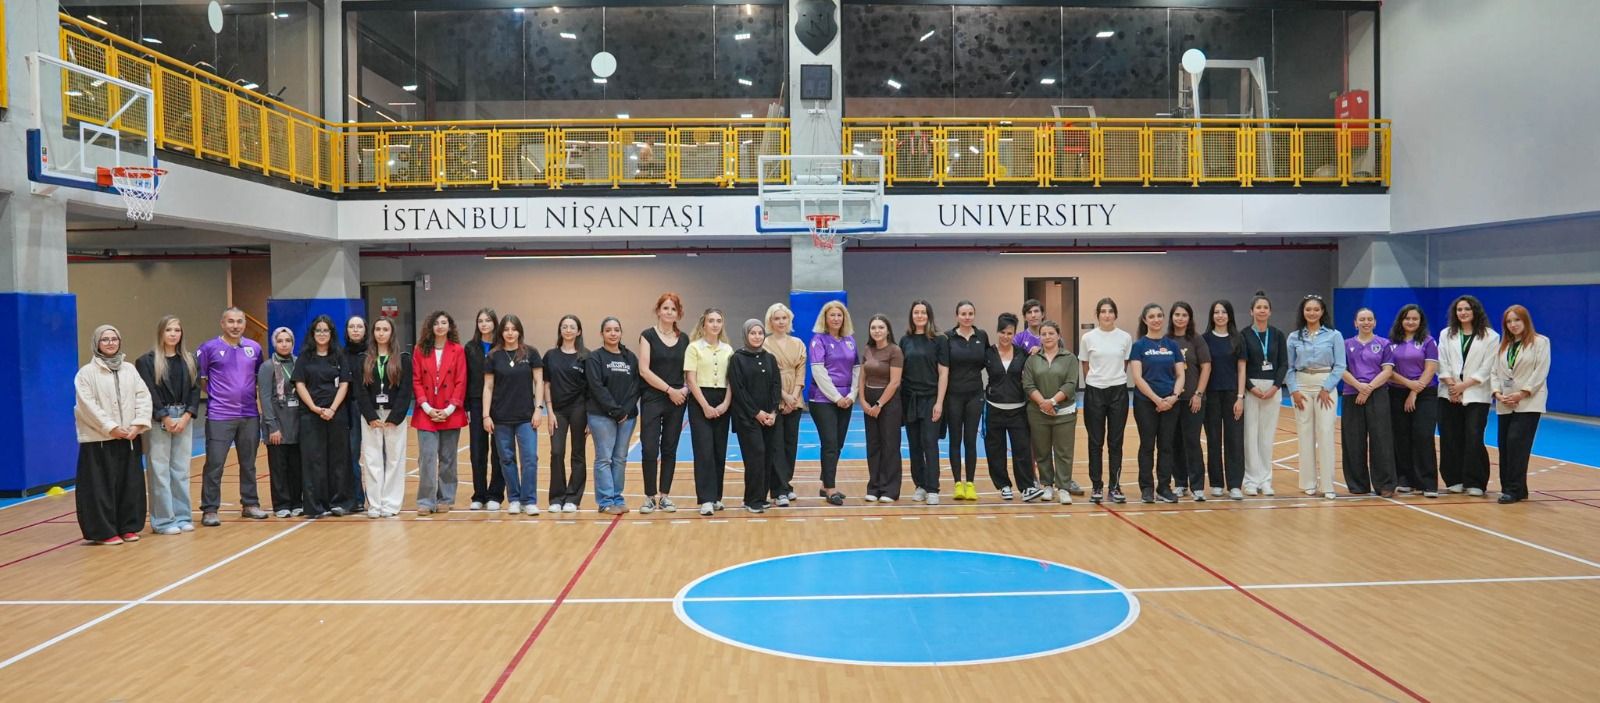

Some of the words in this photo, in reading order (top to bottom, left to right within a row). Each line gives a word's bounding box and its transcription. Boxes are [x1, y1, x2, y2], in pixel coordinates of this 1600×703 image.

[382, 204, 526, 231] İSTANBUL
[545, 201, 705, 234] NİŞANTAŞI
[938, 203, 1118, 227] UNIVERSITY
